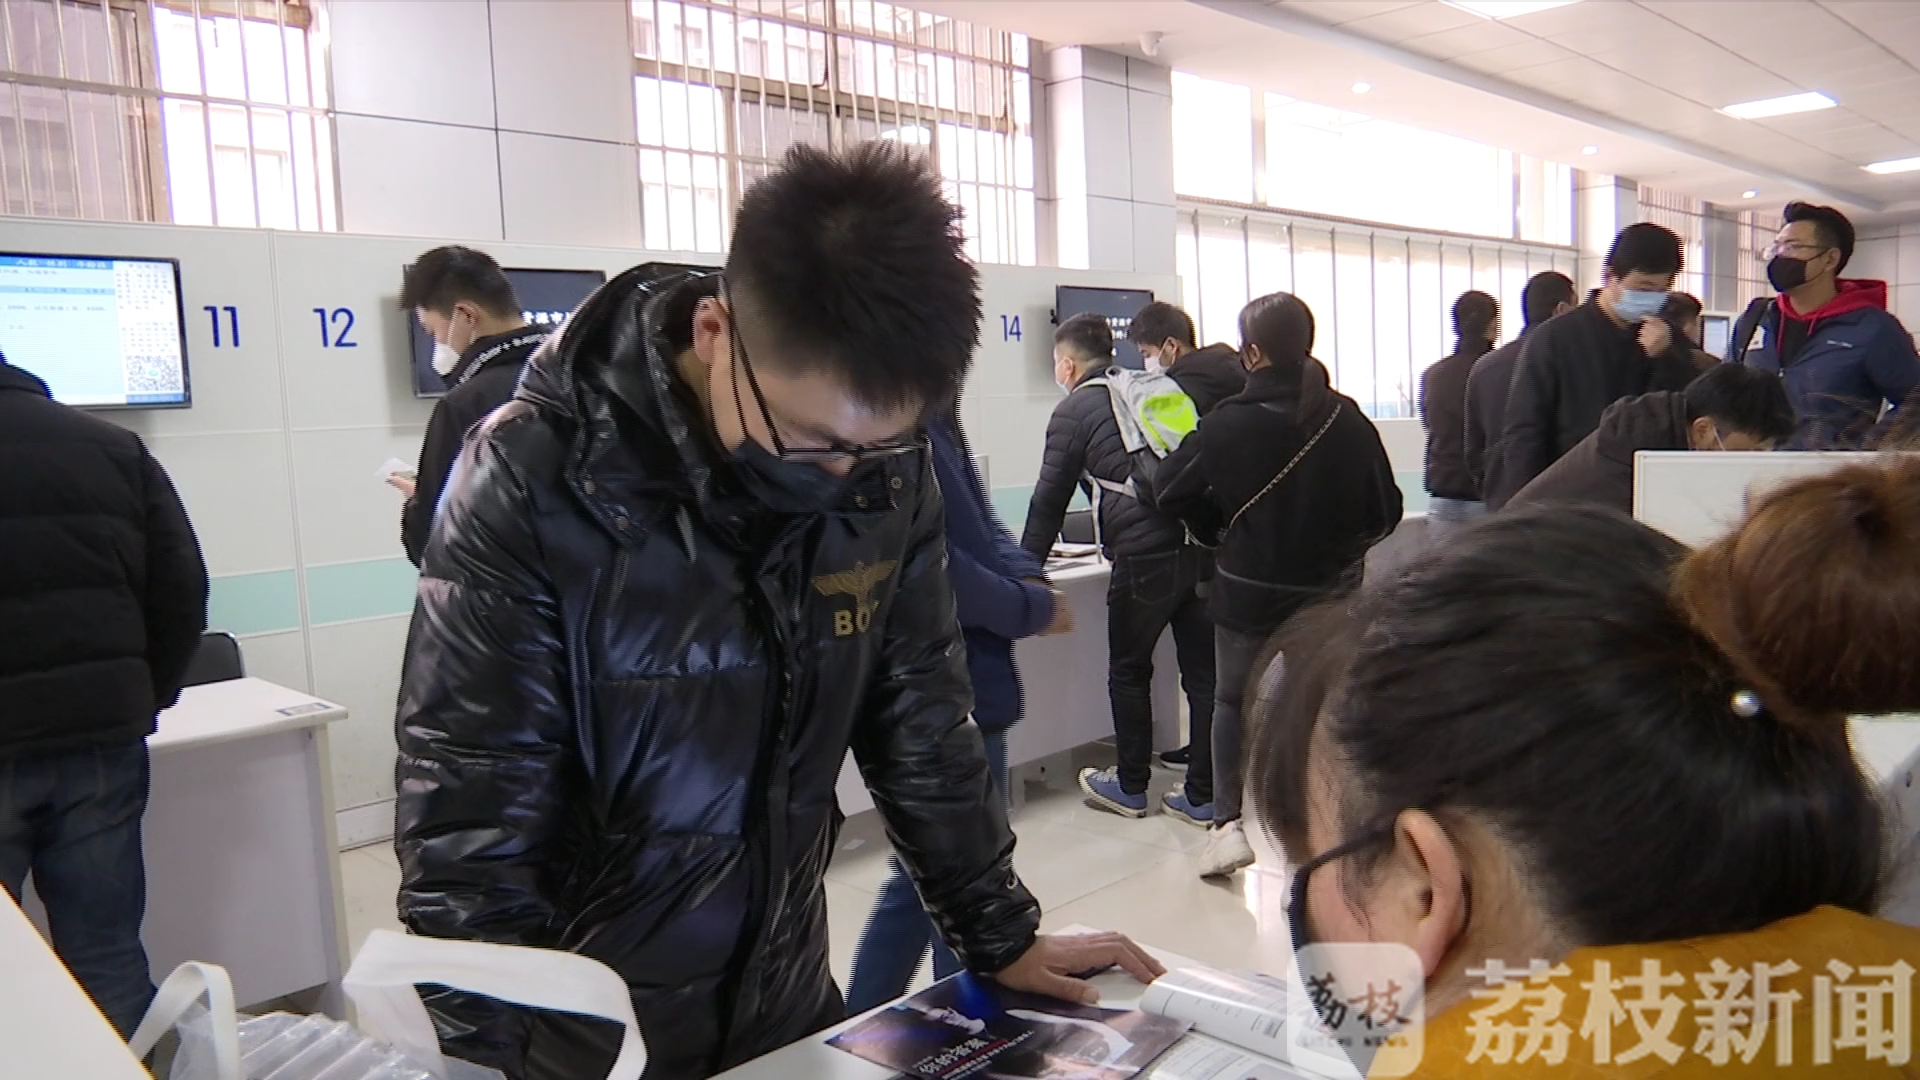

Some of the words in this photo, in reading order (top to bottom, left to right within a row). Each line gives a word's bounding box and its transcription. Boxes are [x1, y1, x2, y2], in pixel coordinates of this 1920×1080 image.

[203, 305, 240, 348] 11
[312, 307, 358, 348] 12
[1001, 314, 1022, 342] 14
[834, 602, 880, 636] BO
